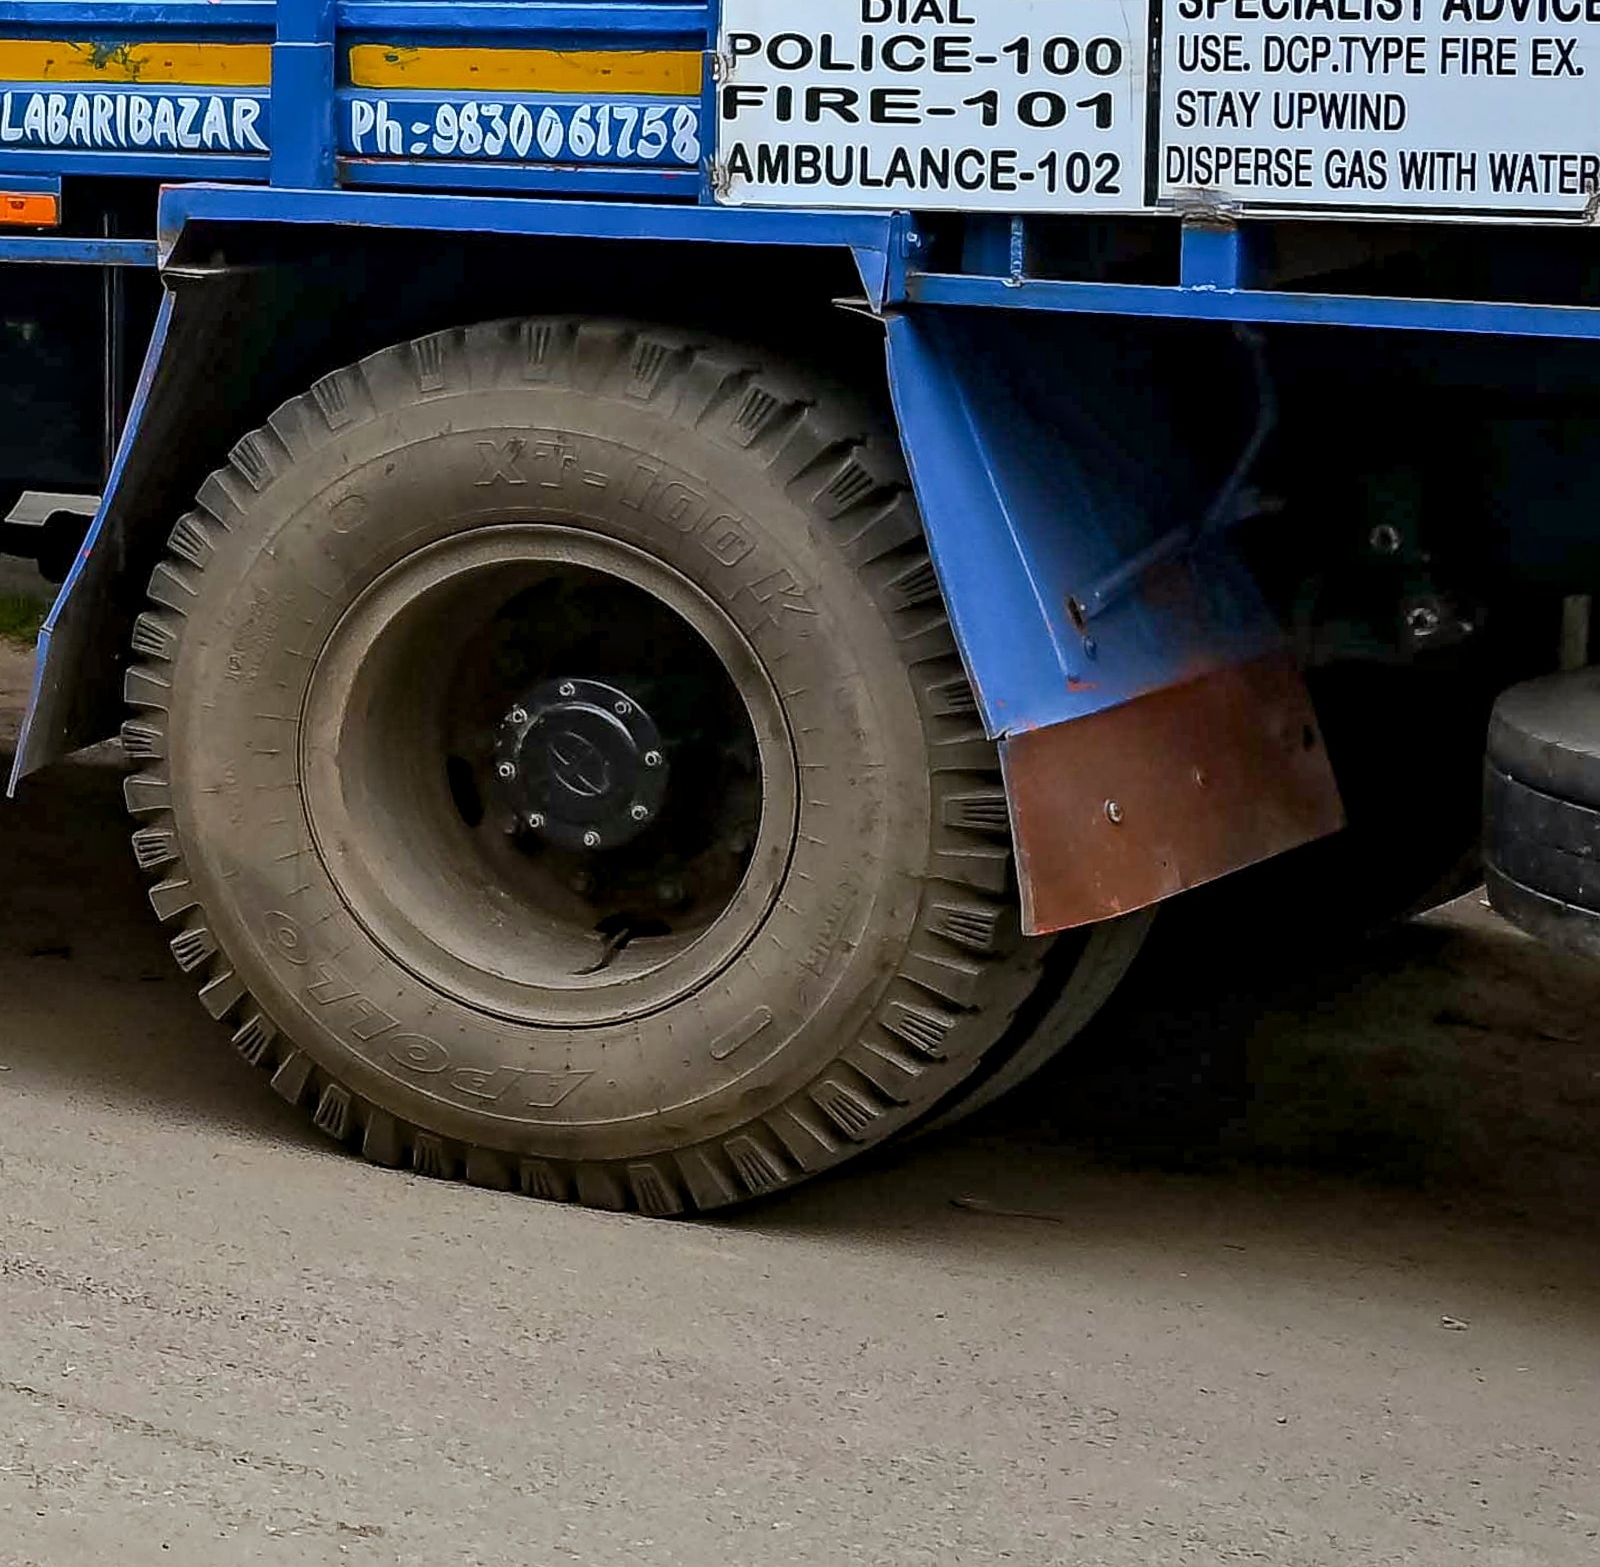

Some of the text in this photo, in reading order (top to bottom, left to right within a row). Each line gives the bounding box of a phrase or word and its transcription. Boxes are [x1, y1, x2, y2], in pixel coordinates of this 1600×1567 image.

[730, 34, 1123, 76] POLICE-100
[1178, 34, 1585, 77] USE. DCP.TYPE FIRE EX.
[722, 84, 1114, 129] FIRE-101
[1176, 89, 1407, 130] STAY UPWIND
[726, 142, 1121, 195] AMBULANCE-102
[1166, 145, 1600, 195] DISPERSE GAS WITH WATER
[263, 910, 595, 1109] APOLLO
